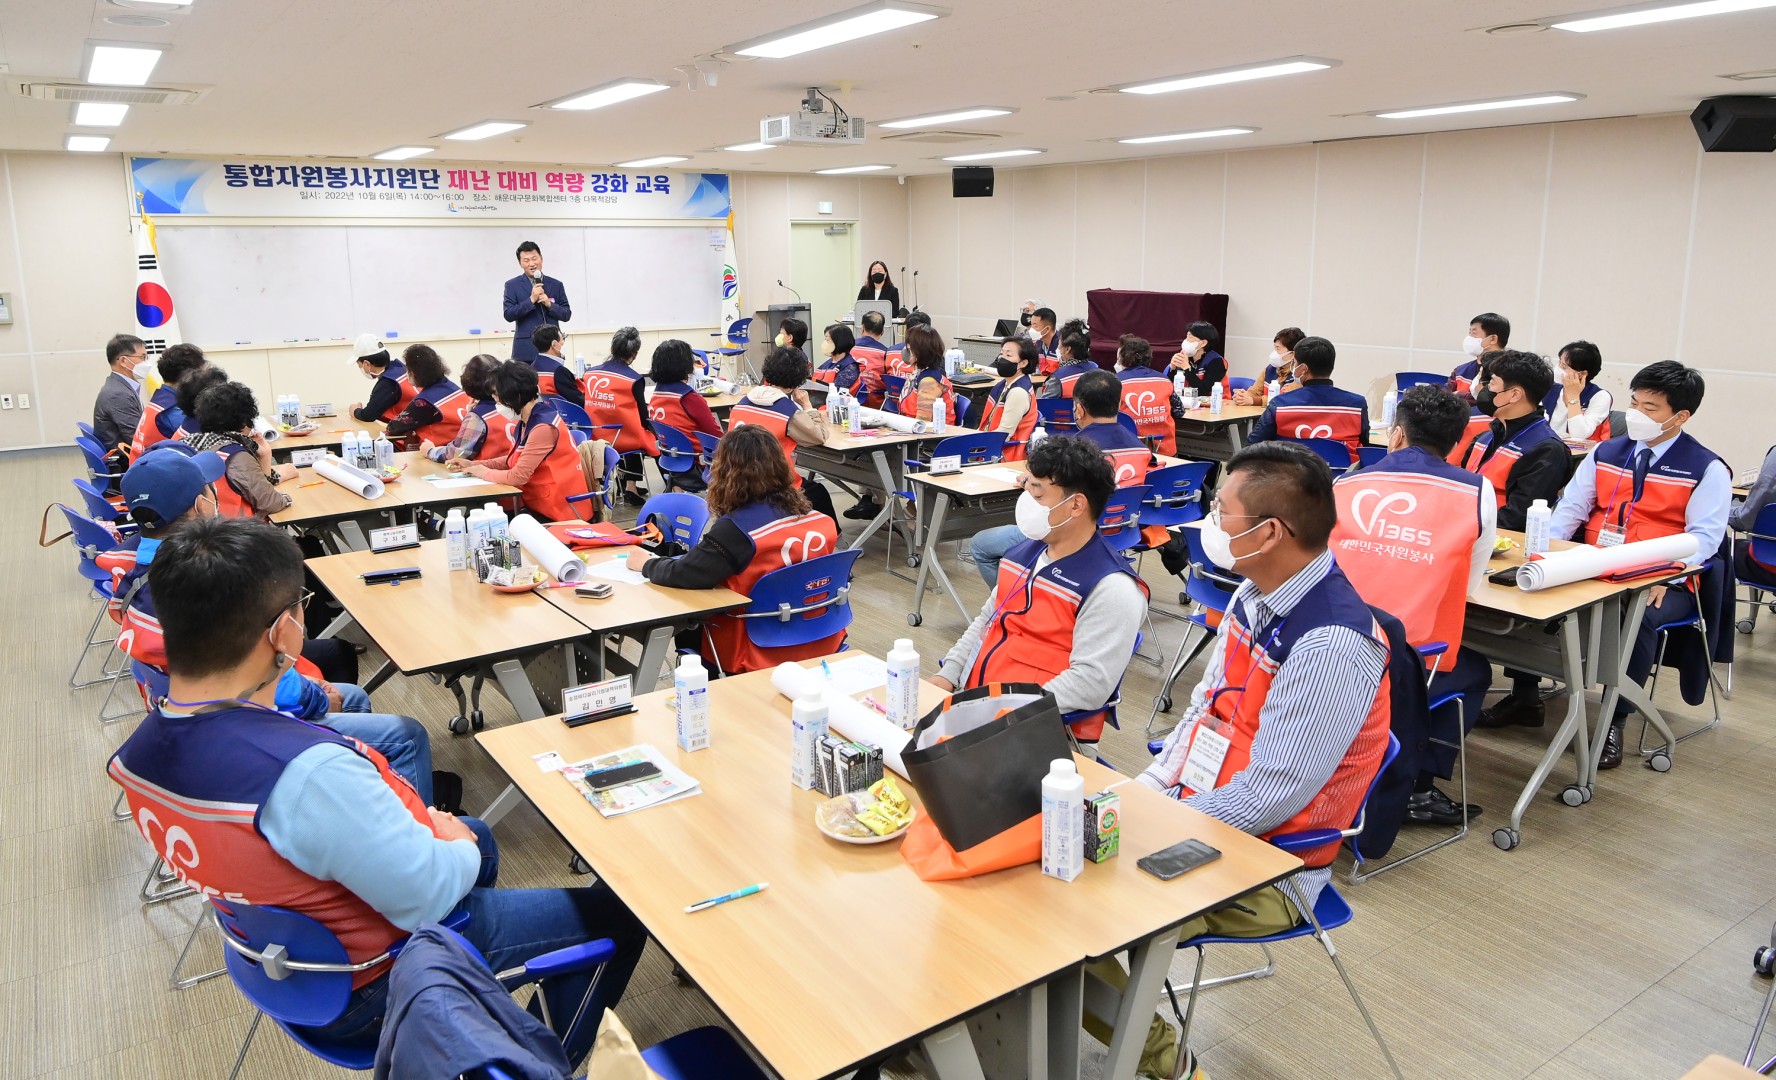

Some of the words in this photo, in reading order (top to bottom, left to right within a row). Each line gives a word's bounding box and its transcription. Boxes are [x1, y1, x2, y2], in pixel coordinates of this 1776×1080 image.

[223, 164, 440, 189] 통합자원봉사지원단
[447, 169, 490, 191] 재난
[497, 171, 538, 191] 대비
[545, 172, 585, 193] 역량
[591, 173, 628, 193] 강화
[635, 174, 670, 194] 교육
[299, 191, 321, 200] 일시:
[325, 191, 354, 200] 2022년
[358, 192, 376, 200] 10월
[379, 192, 407, 201] 6일(목)
[410, 192, 465, 201] 14:00~16:00
[472, 193, 491, 202] 장소:
[494, 194, 567, 203] 해운대구문화복합센터
[594, 389, 615, 401] 1365
[1141, 405, 1166, 416] 1365
[1377, 518, 1433, 547] 1365
[1339, 538, 1436, 565] 대한민국자원봉사
[582, 702, 590, 711] 김
